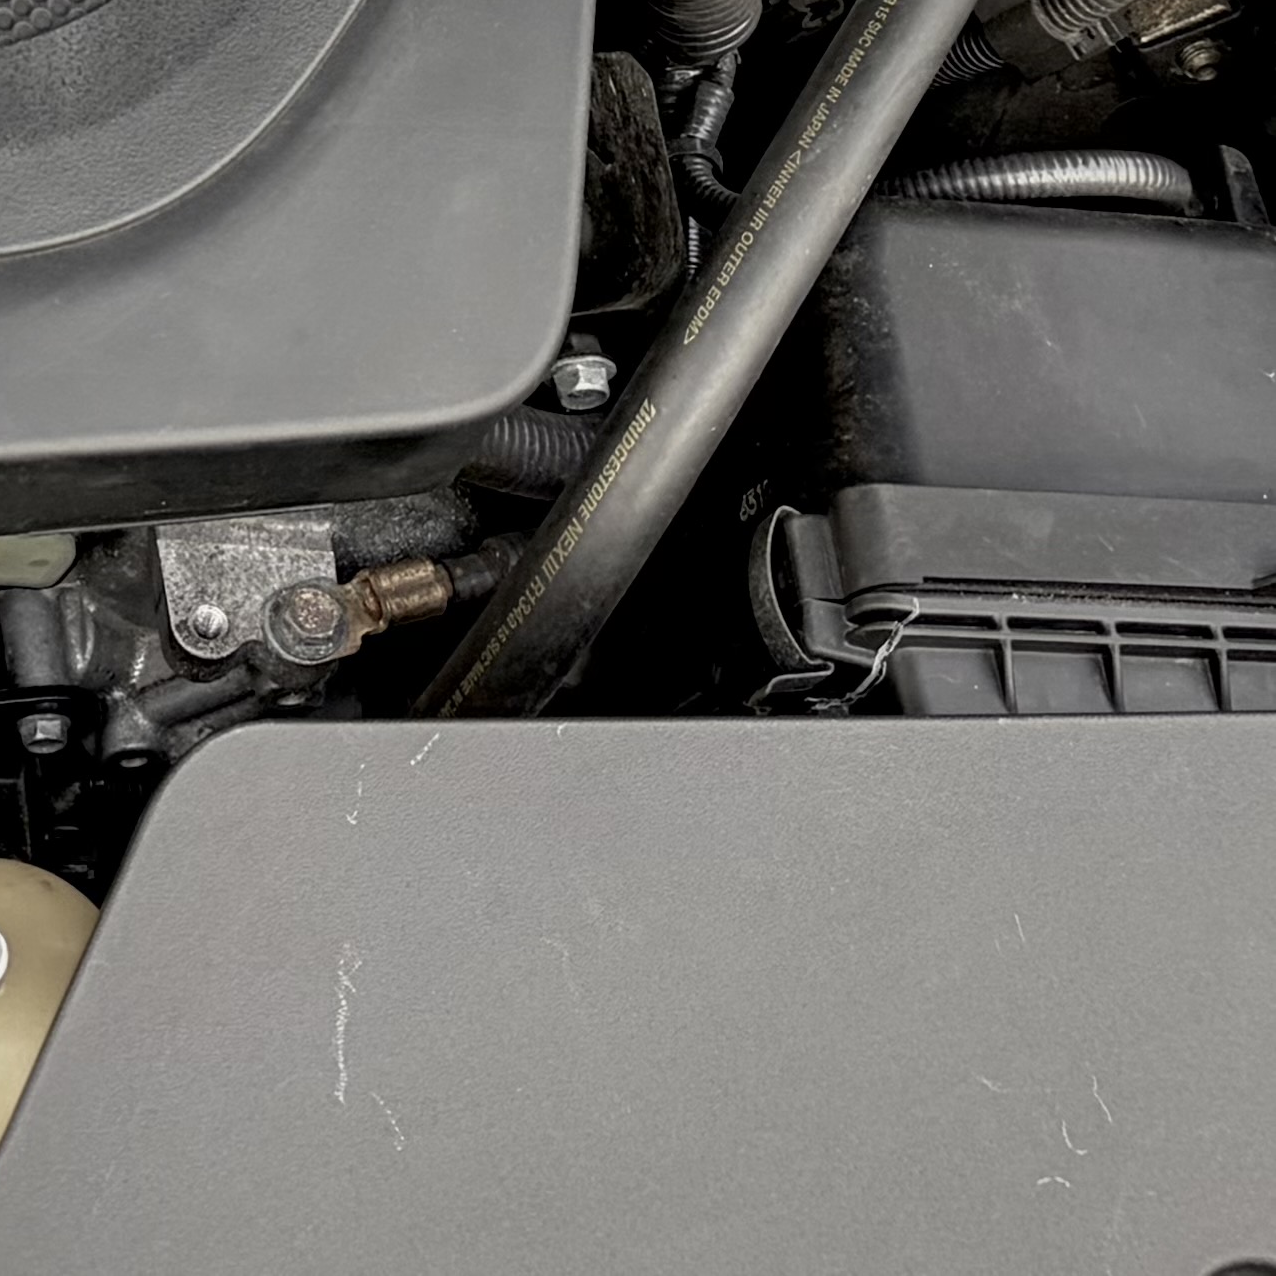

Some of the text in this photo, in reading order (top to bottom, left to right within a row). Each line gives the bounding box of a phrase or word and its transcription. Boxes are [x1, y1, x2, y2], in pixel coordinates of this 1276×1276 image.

[856, 18, 881, 48] SUC
[833, 46, 864, 86] MADE
[824, 85, 841, 102] IN
[796, 101, 832, 148] JAPAN
[714, 229, 756, 286] OUTER
[573, 398, 659, 522] BRIDGESTONE
